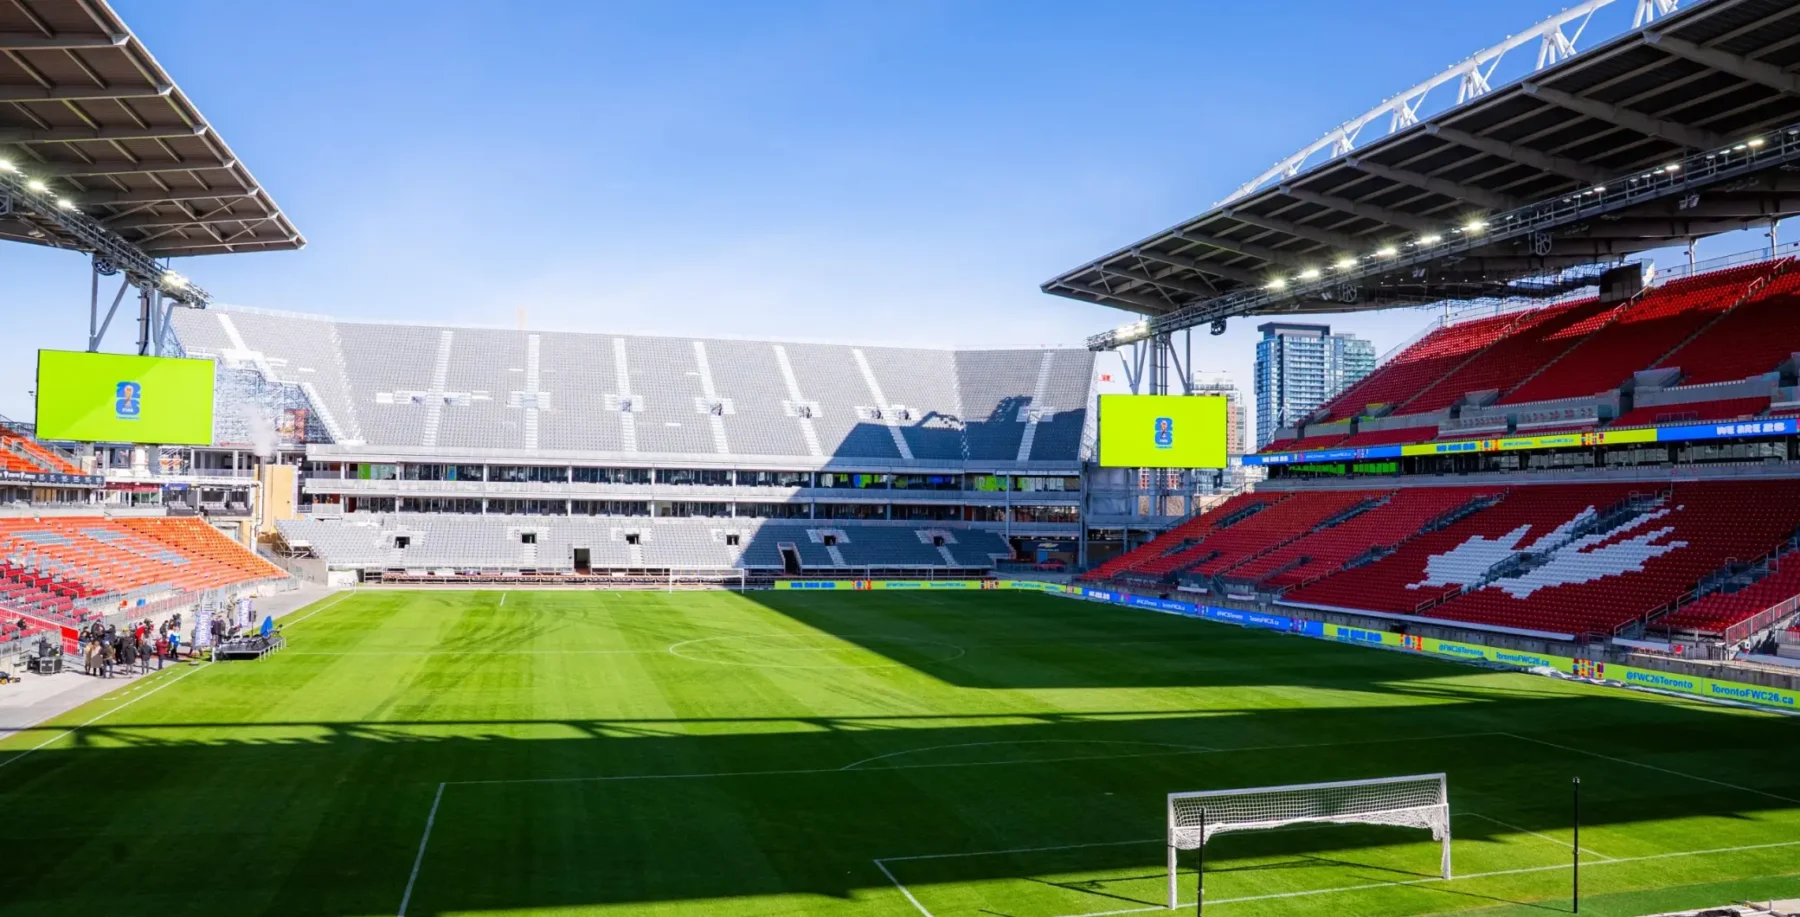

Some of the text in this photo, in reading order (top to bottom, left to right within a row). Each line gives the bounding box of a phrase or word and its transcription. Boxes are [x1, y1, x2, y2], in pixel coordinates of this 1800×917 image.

[1717, 426, 1734, 435] WE
[1737, 424, 1760, 434] ARE
[1626, 671, 1693, 689] @FWC26Toronto
[1711, 684, 1794, 705] TorontoFWC26.ca
